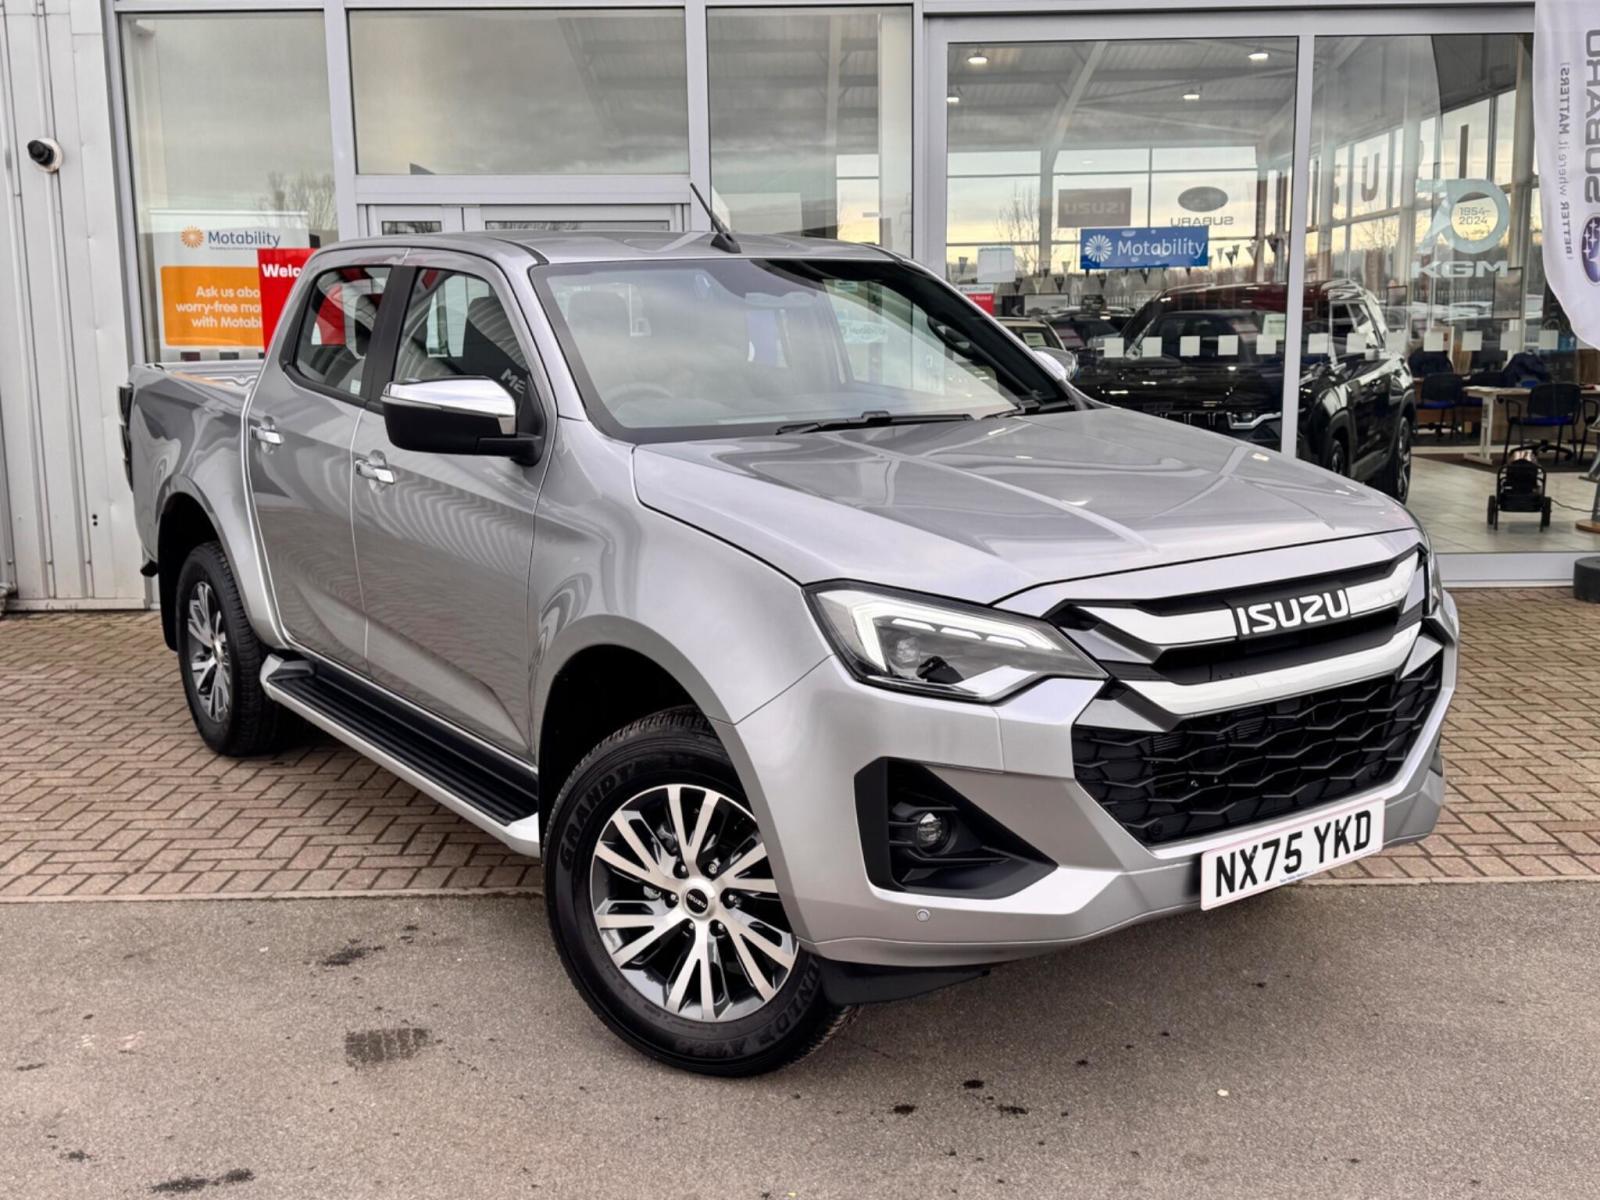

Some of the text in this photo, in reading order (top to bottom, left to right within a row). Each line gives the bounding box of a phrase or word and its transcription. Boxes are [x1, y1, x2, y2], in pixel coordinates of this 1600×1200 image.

[208, 231, 281, 248] Motability
[1117, 237, 1206, 259] Motability
[1410, 260, 1509, 279] KGM
[195, 286, 218, 298] Ask
[220, 288, 235, 298] us
[176, 301, 238, 315] worry-free
[192, 316, 218, 329] with
[1236, 589, 1349, 636] ISUZU
[1216, 809, 1371, 898] NX75 YKD
